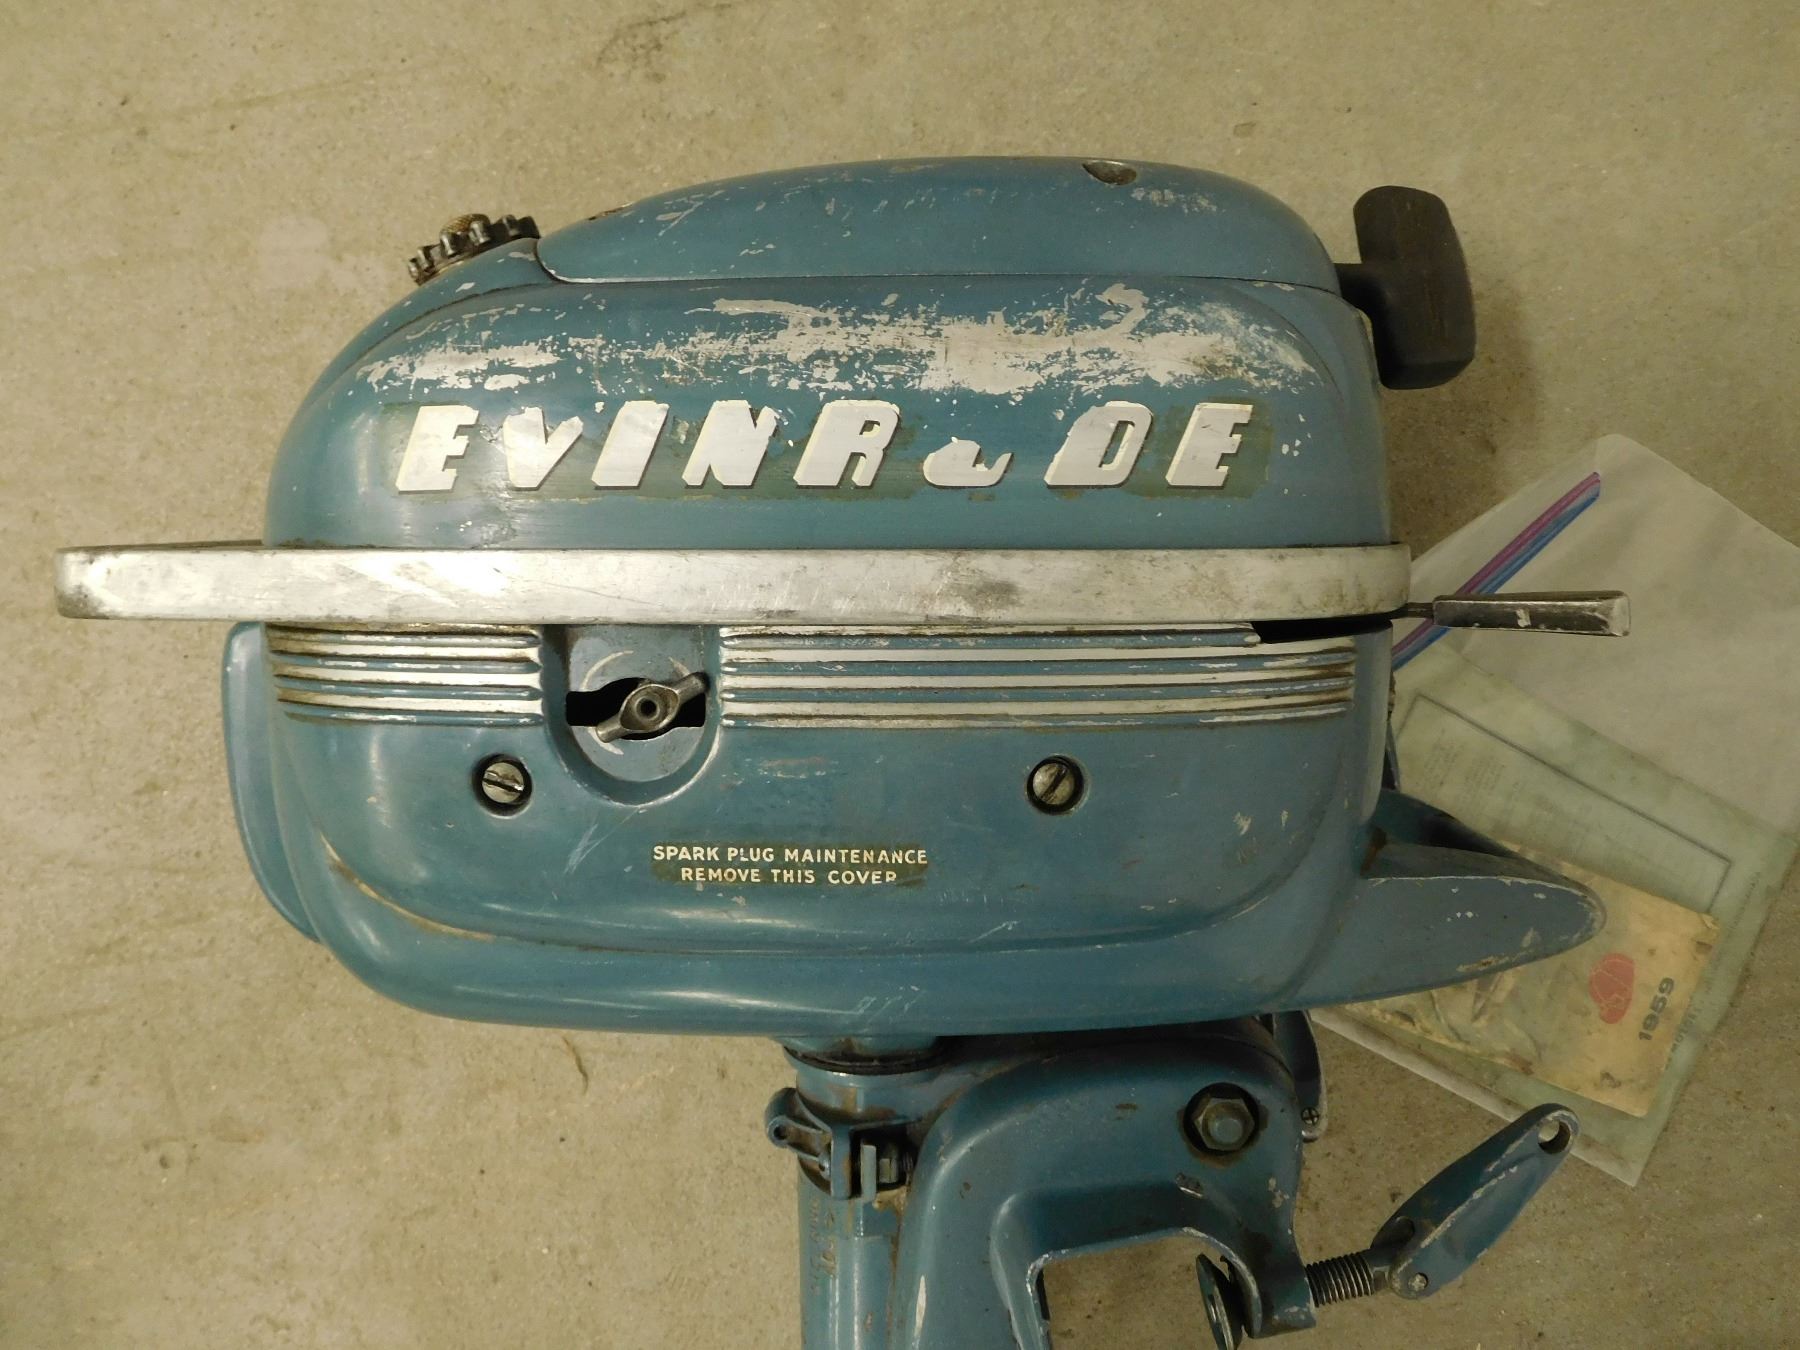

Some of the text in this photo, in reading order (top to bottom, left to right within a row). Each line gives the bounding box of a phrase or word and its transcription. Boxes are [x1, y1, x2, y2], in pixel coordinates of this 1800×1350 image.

[653, 845, 929, 865] SPARK PLUG MAINTENANCE
[681, 867, 898, 885] REMOVE THIS COVER
[1638, 977, 1675, 1041] 1959
